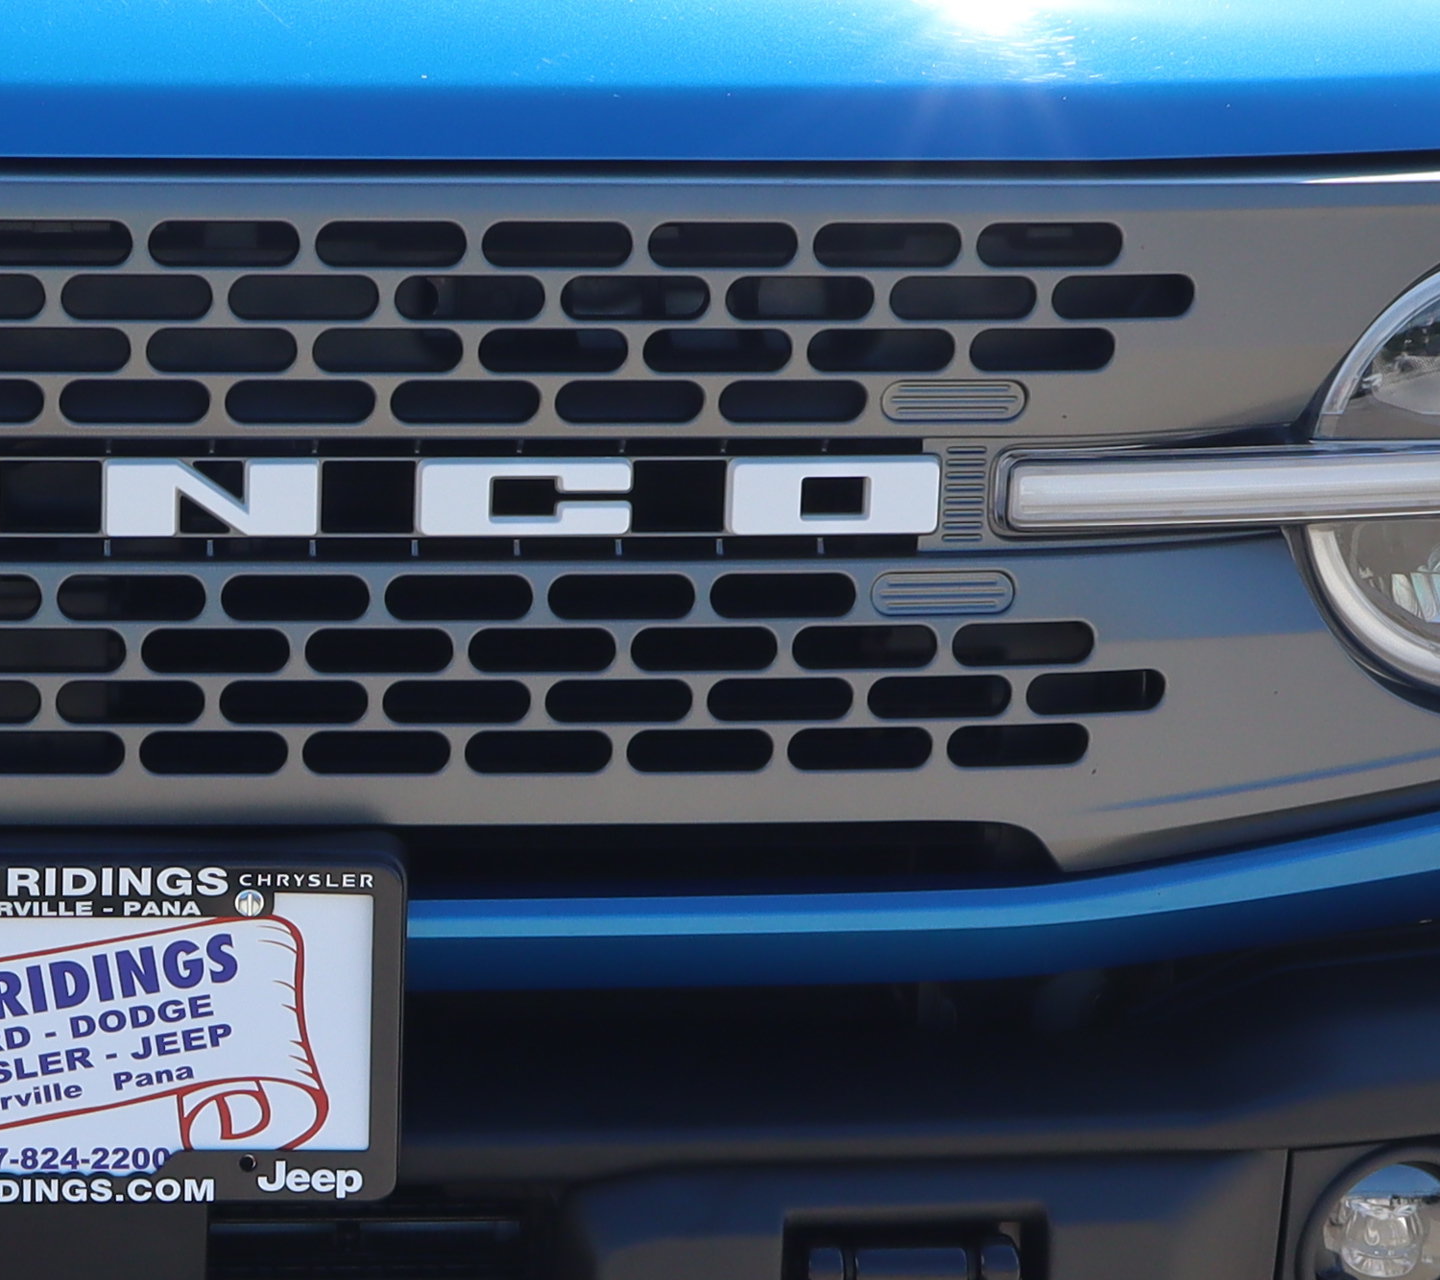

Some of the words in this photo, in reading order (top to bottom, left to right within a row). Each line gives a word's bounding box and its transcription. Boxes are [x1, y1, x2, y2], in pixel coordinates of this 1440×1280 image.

[7, 867, 229, 897] RIDINGS
[239, 873, 374, 889] CHRYSLER
[122, 901, 201, 917] PANA
[69, 994, 214, 1039] DODGE
[130, 1022, 233, 1061] JEEP
[114, 1065, 195, 1092] Pana
[258, 1161, 363, 1198] Jeep
